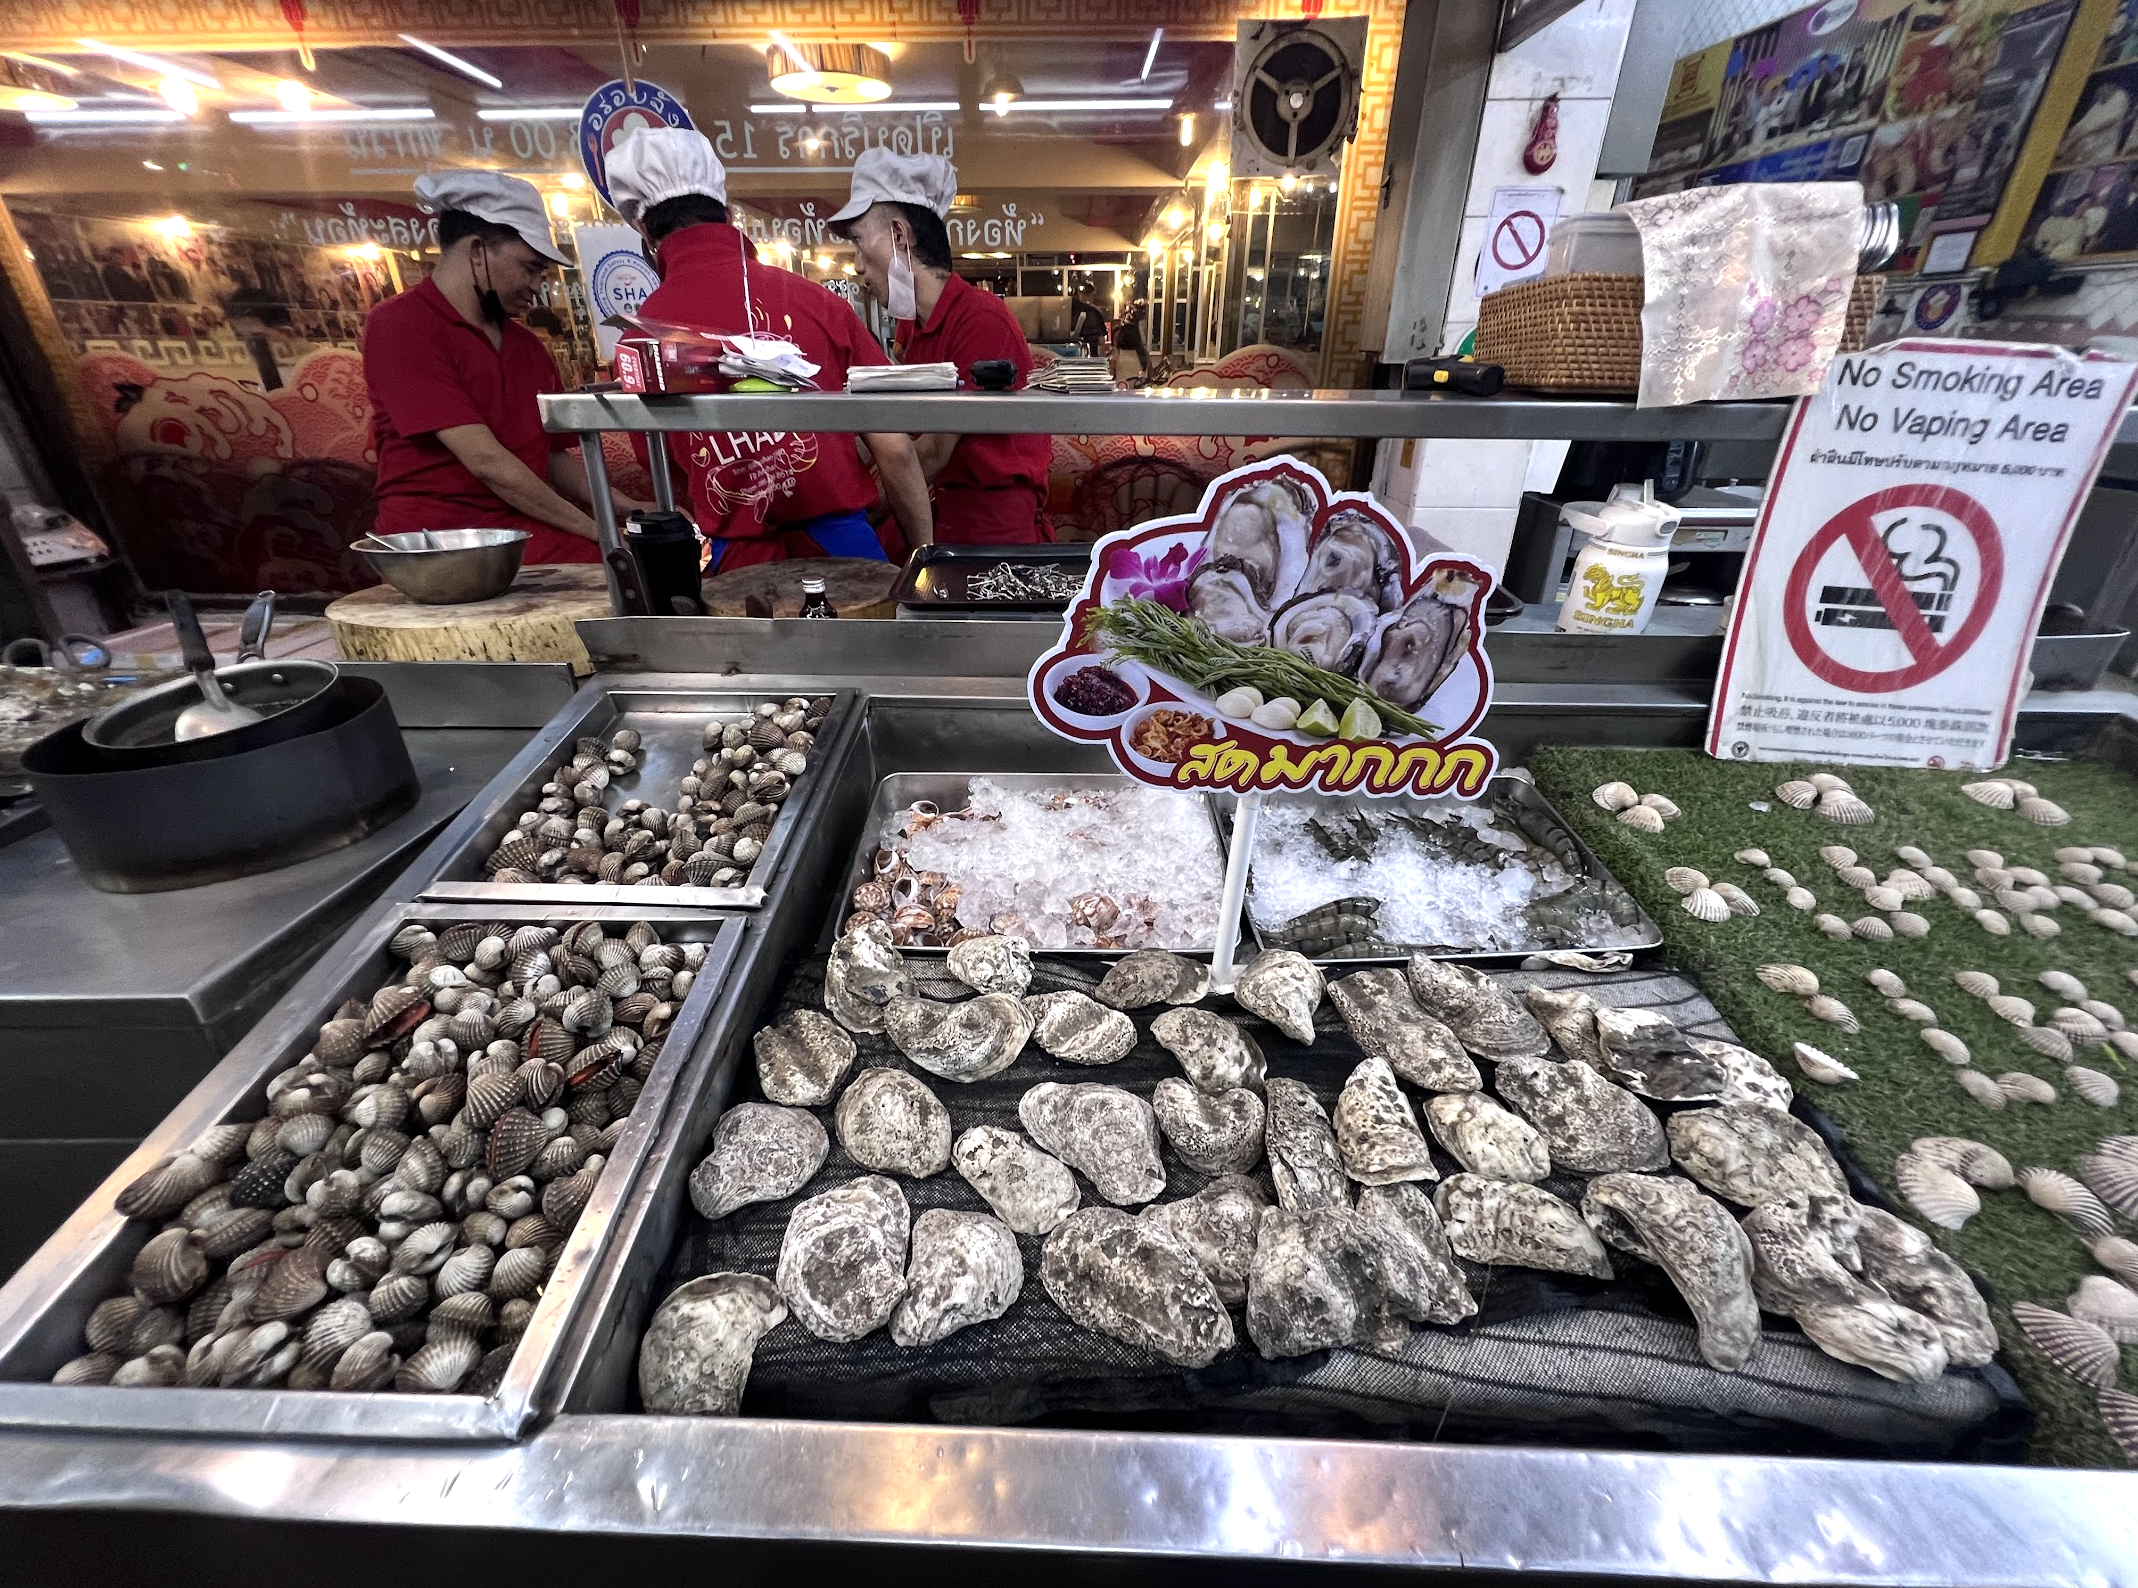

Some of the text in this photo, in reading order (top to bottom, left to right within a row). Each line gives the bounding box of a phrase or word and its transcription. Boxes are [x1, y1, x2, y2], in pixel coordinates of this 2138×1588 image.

[612, 287, 648, 301] SHA
[1837, 357, 2106, 401] No Smoking Area
[1834, 403, 2070, 446] No Vaping Area
[1606, 547, 1645, 559] SINGHA
[1572, 609, 1635, 629] SINGHA
[1176, 739, 1488, 790] สดมากกก
